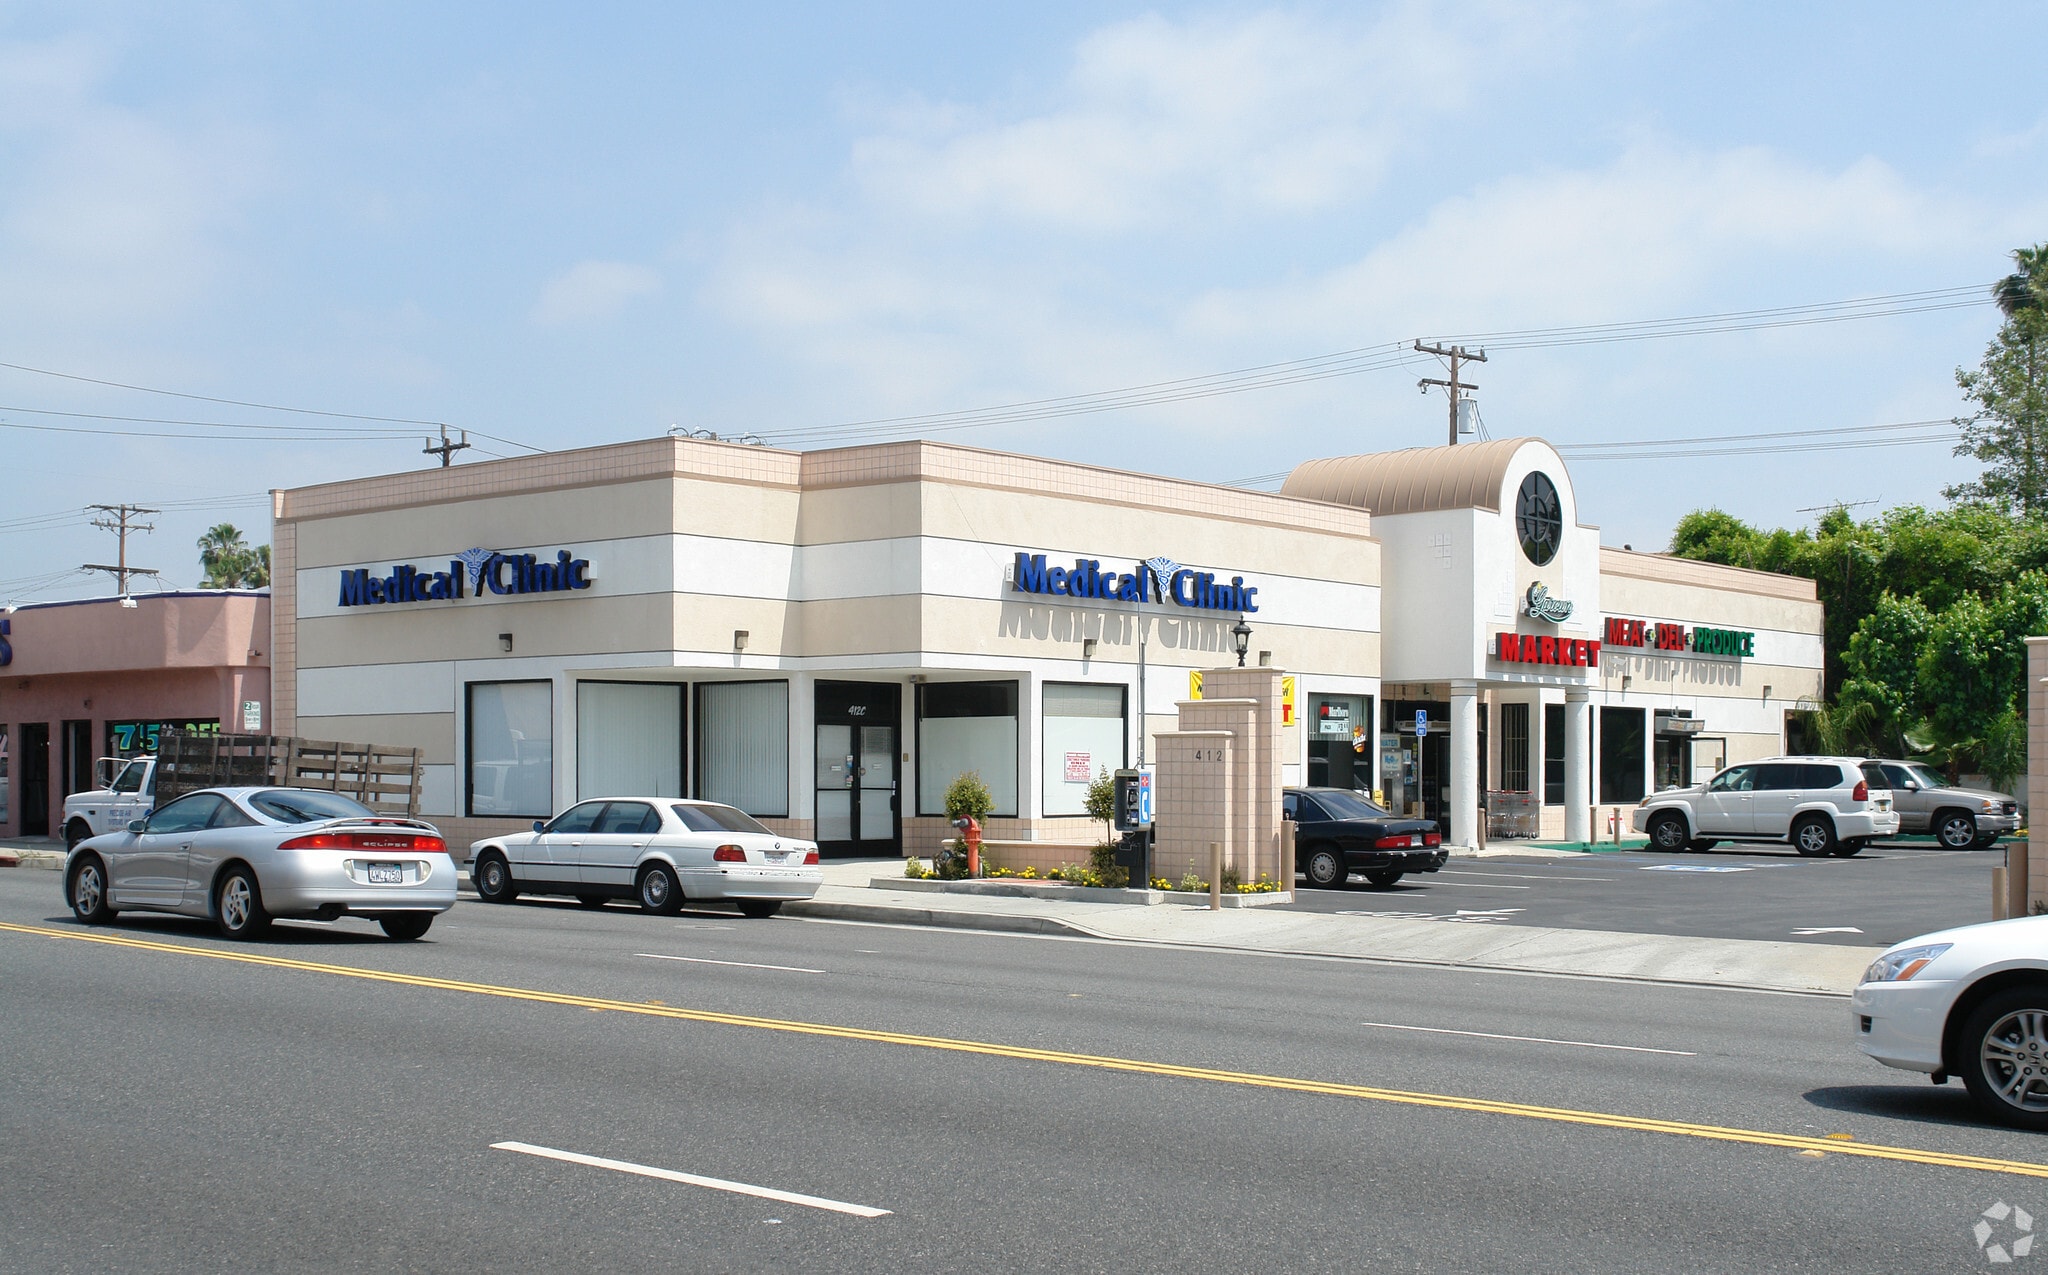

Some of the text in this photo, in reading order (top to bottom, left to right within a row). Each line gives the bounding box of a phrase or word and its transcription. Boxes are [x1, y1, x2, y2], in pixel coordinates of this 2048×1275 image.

[338, 550, 591, 606] Medical Clinic
[1012, 552, 1259, 612] Medical Clinic
[1496, 632, 1601, 667] MARKET
[1604, 617, 1646, 647] MEAT
[1693, 627, 1755, 657] PRODUCE
[245, 702, 251, 710] 2
[1196, 751, 1222, 761] 412
